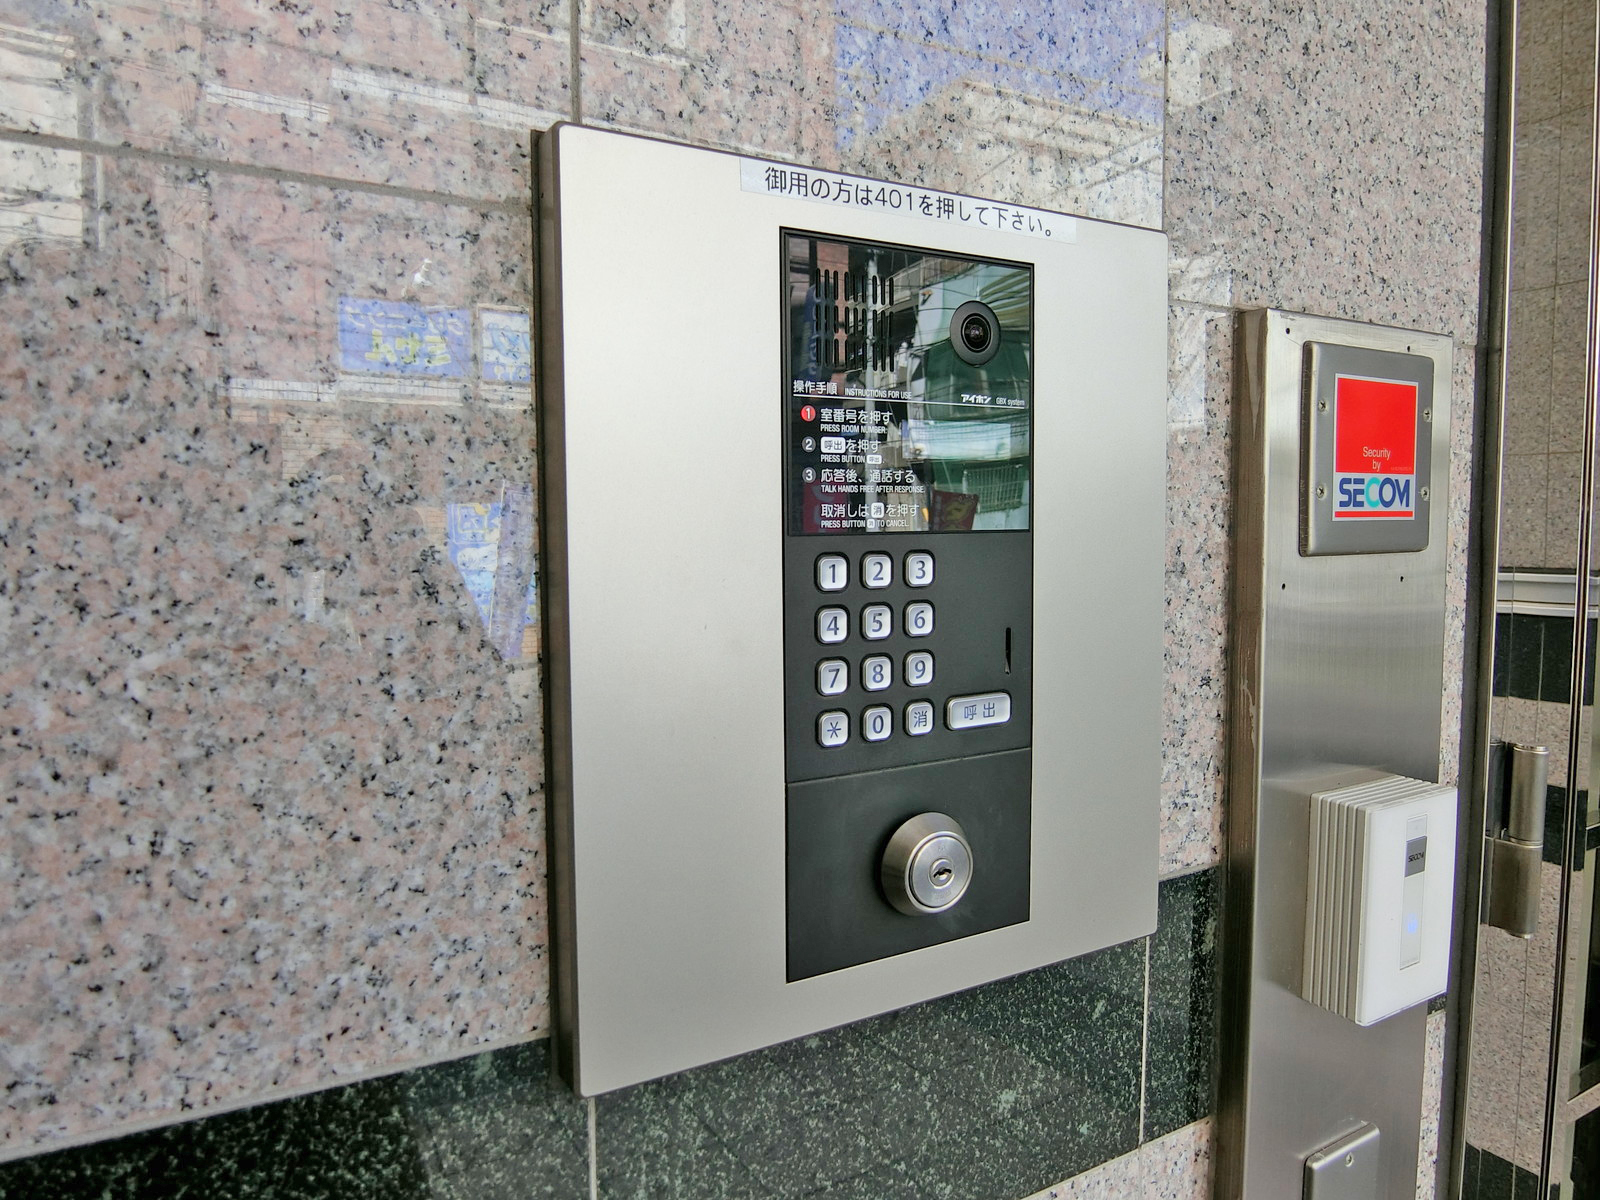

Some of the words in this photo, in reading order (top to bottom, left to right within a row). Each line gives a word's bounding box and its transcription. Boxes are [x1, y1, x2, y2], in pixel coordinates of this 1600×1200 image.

[764, 166, 1052, 238] 御用の方は401を押して下さい。
[793, 379, 838, 395] 操作手順
[844, 387, 887, 399] INSTRUCTIONS
[888, 390, 900, 399] FOR
[900, 391, 912, 400] USE
[961, 394, 992, 404] アイホン
[996, 397, 1007, 405] GBX
[1007, 399, 1025, 407] system
[820, 408, 893, 425] 室番号を押す
[820, 424, 841, 433] PRESS
[841, 425, 860, 434] ROOM
[820, 454, 841, 463] PRESS
[841, 455, 866, 464] BUTTON
[1362, 446, 1391, 461] Security
[1372, 459, 1381, 472] by
[820, 468, 916, 484] 応答後、通話する
[821, 485, 837, 493] TALK
[838, 485, 859, 493] HANDS
[859, 485, 875, 493] FREE
[875, 485, 894, 493] AFTER
[1338, 477, 1411, 509] SECOM
[820, 520, 840, 529] PRESS
[841, 520, 866, 529] BUTTON
[877, 519, 885, 528] TO
[827, 563, 837, 584] 1
[872, 561, 885, 581] 2
[915, 559, 927, 580] 3
[826, 615, 840, 636] 4
[871, 612, 883, 633] 5
[914, 610, 926, 629] 6
[827, 667, 841, 689] 7
[872, 663, 885, 684] 8
[914, 660, 926, 679] 9
[963, 701, 996, 721] 呼出
[872, 714, 885, 735] 0
[913, 710, 928, 729] 消
